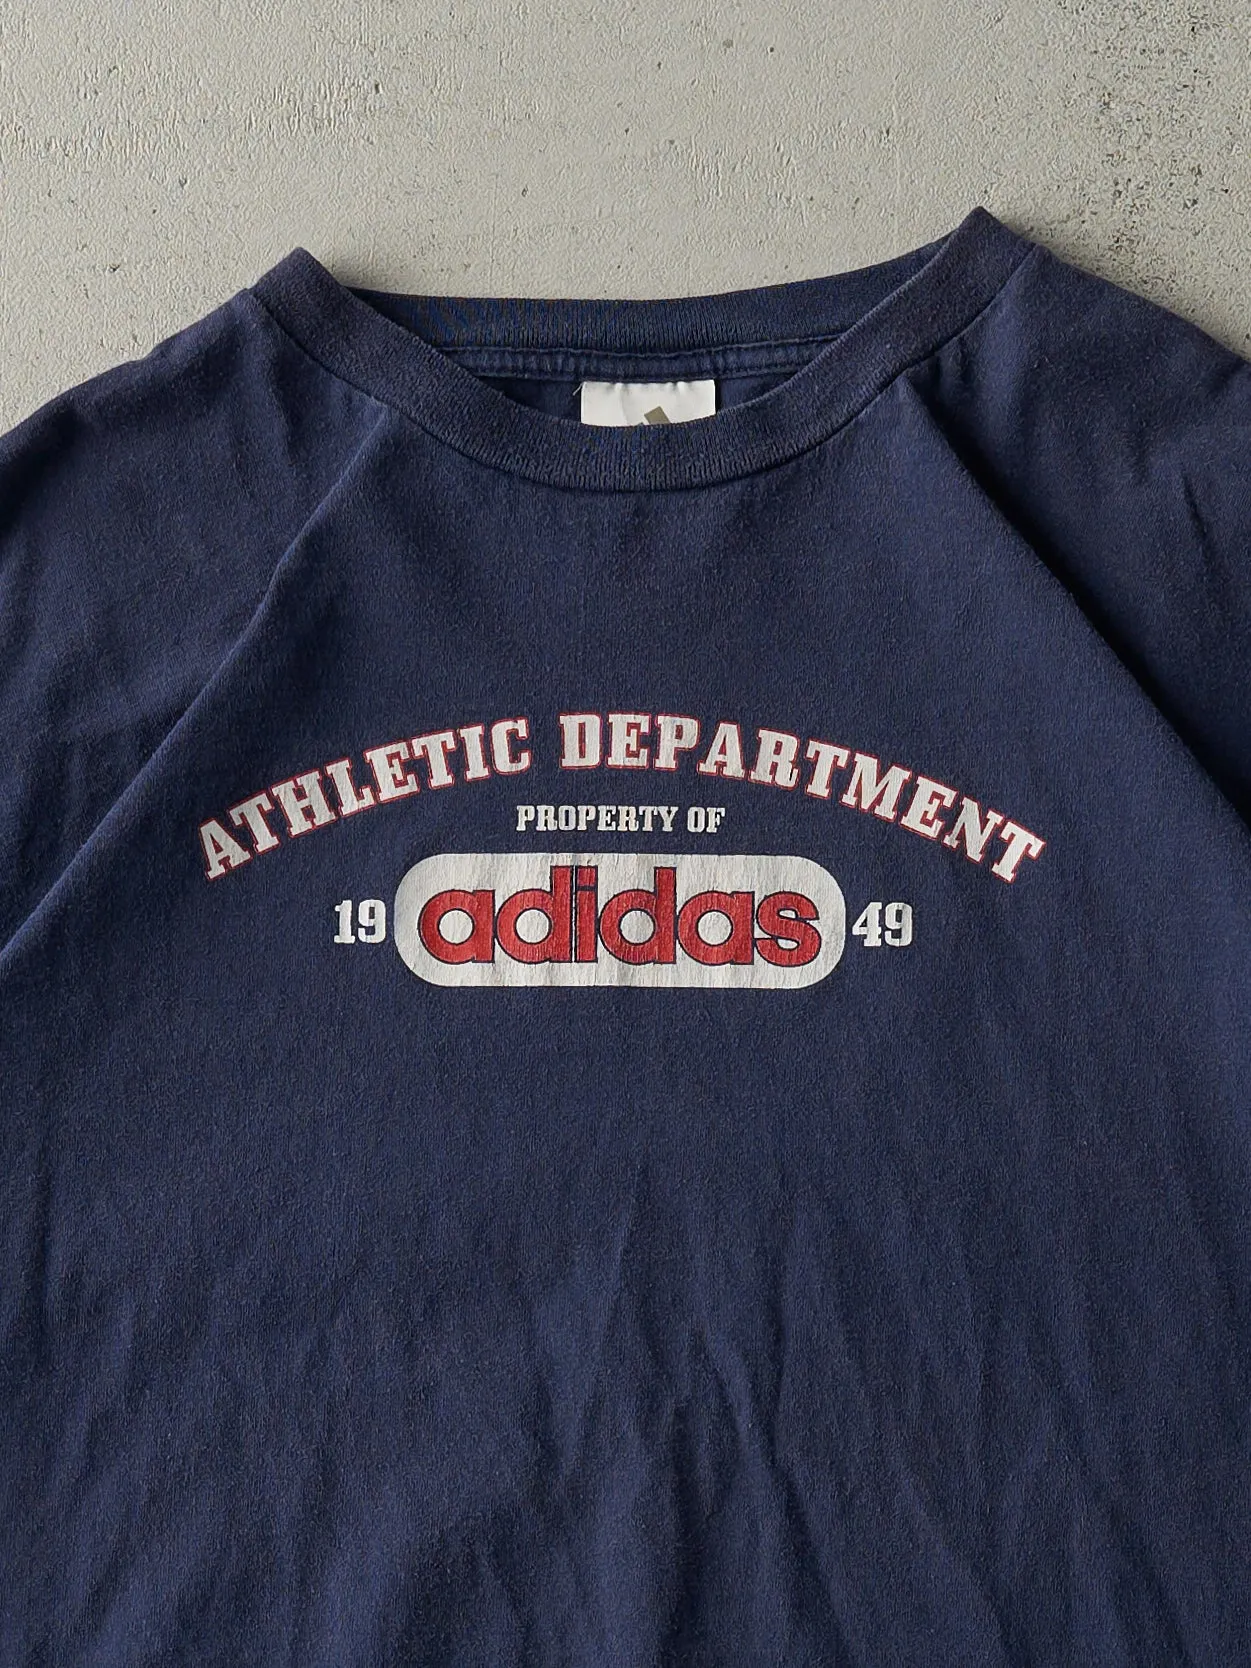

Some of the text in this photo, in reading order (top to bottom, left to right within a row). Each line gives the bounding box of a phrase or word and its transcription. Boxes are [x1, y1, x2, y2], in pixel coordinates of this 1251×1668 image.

[199, 711, 1047, 884] ATHLETIC DEPARTMENT
[515, 805, 726, 833] PROPERTY OF
[333, 898, 387, 945] 19
[418, 864, 823, 968] adidas
[851, 901, 914, 947] 49
